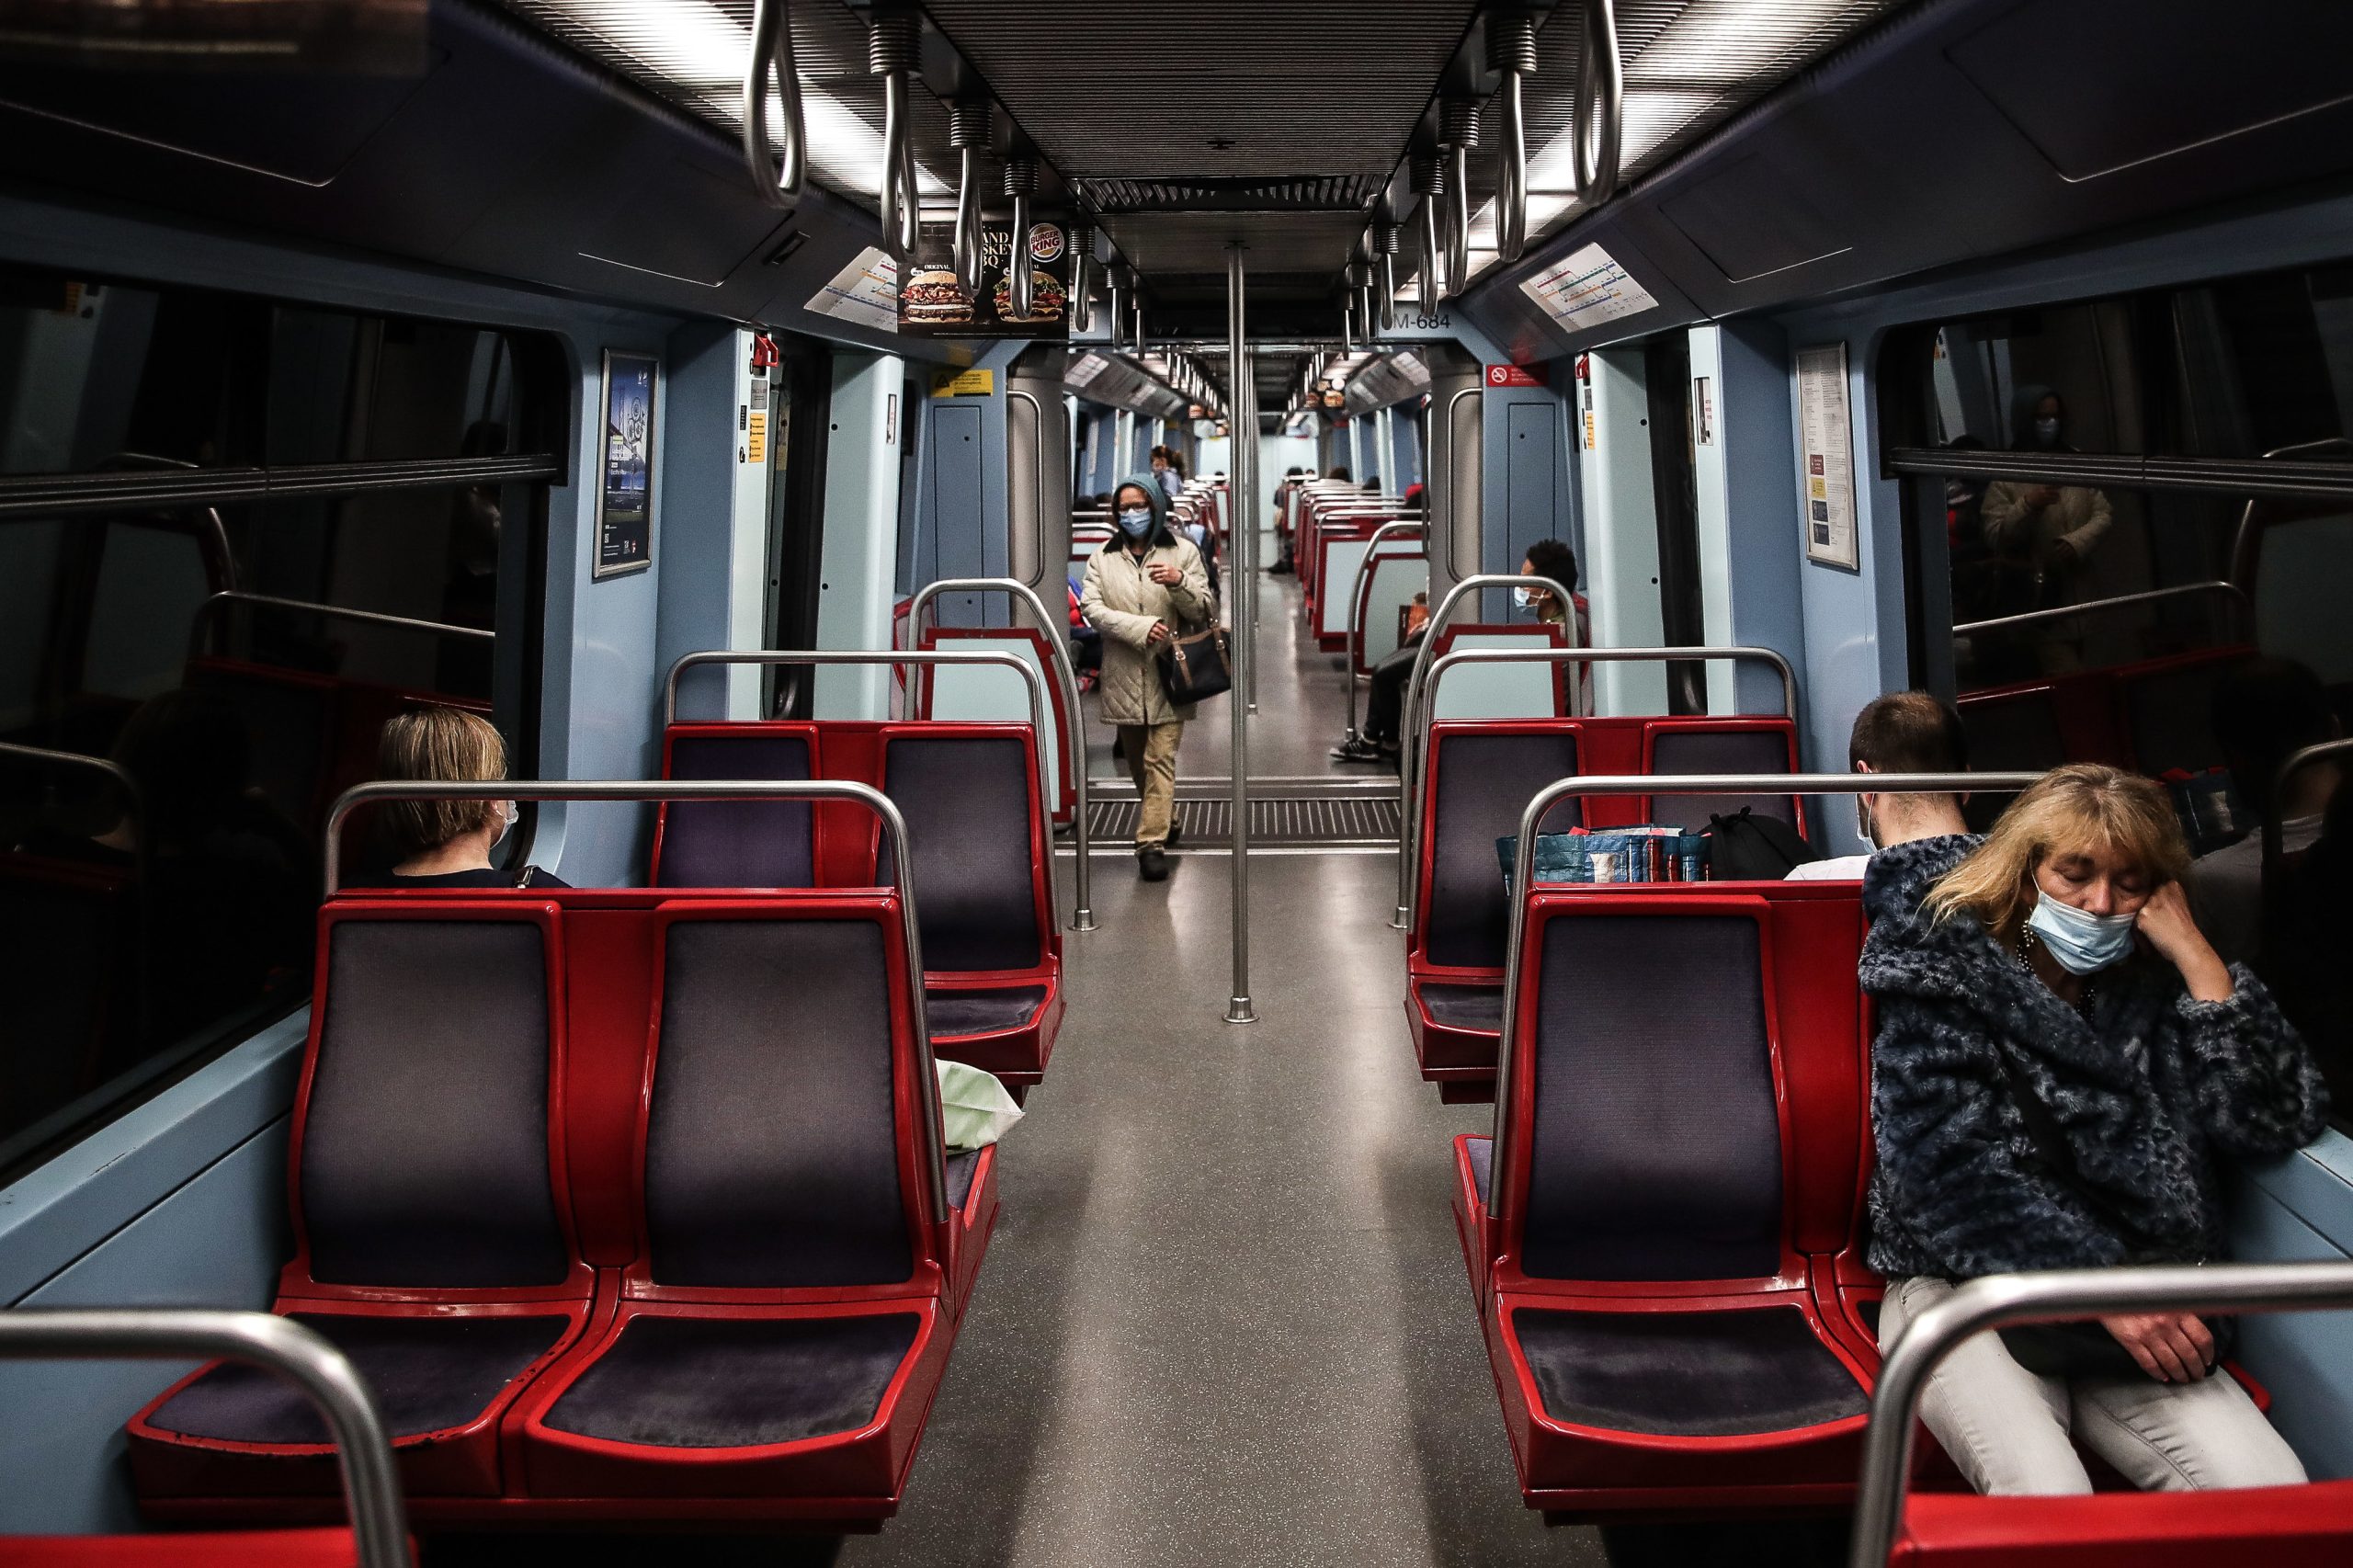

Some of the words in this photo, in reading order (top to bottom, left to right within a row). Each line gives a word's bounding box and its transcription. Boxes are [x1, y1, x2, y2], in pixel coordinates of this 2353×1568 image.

[1031, 231, 1059, 244] BURGER
[1031, 238, 1060, 254] KING
[1393, 312, 1451, 329] M-684
